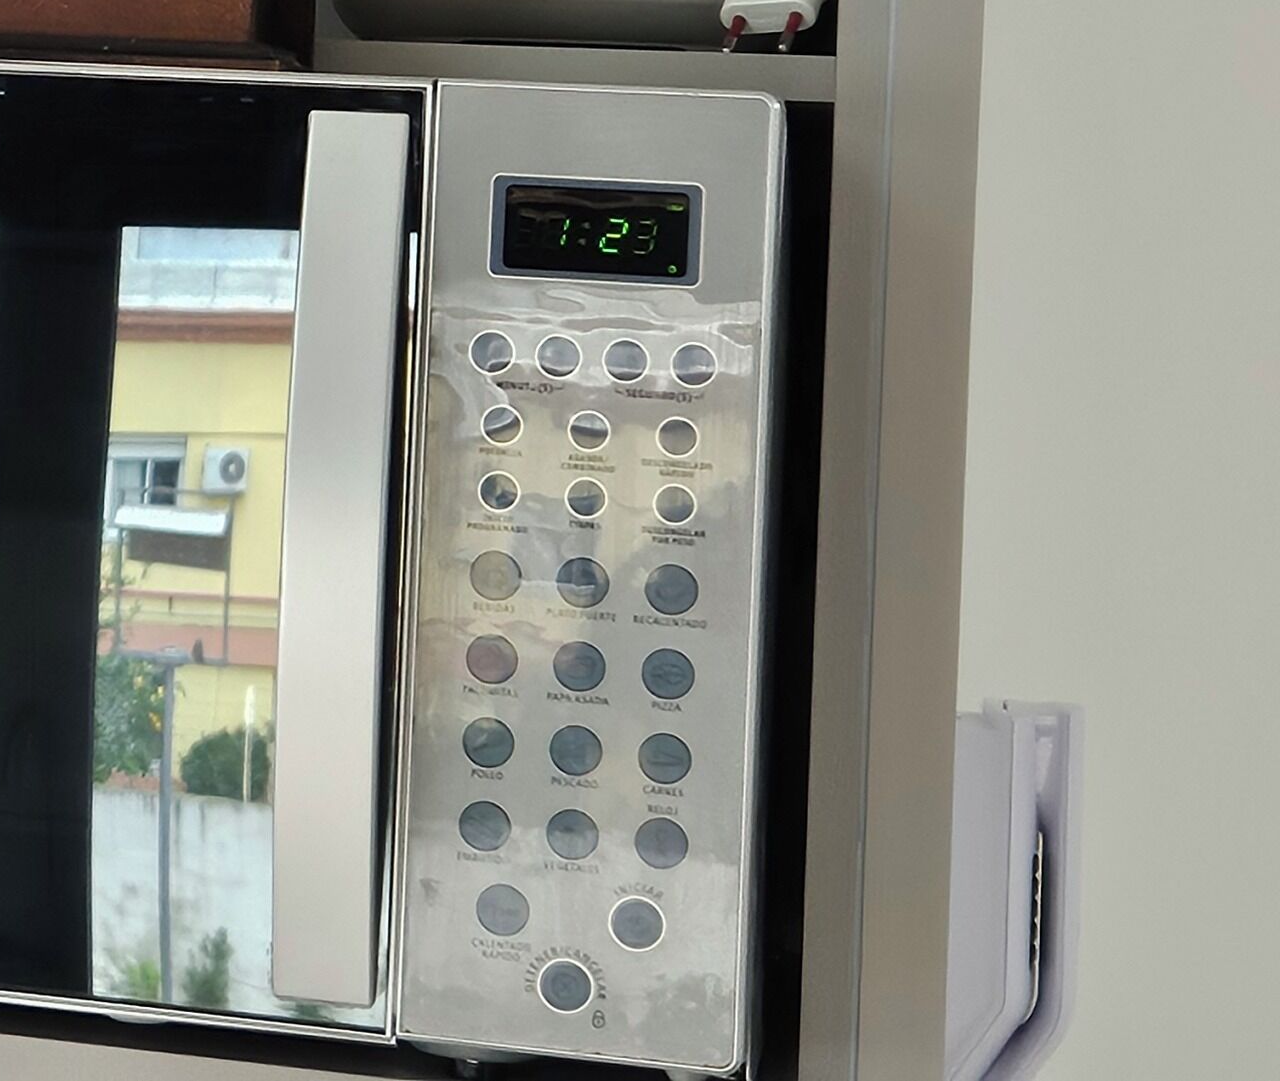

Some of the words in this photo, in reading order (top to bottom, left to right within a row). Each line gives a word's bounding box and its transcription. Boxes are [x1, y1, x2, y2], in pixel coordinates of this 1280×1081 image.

[651, 699, 684, 713] PIZZA
[470, 769, 505, 781] POLLO
[613, 882, 665, 901] INICIAR
